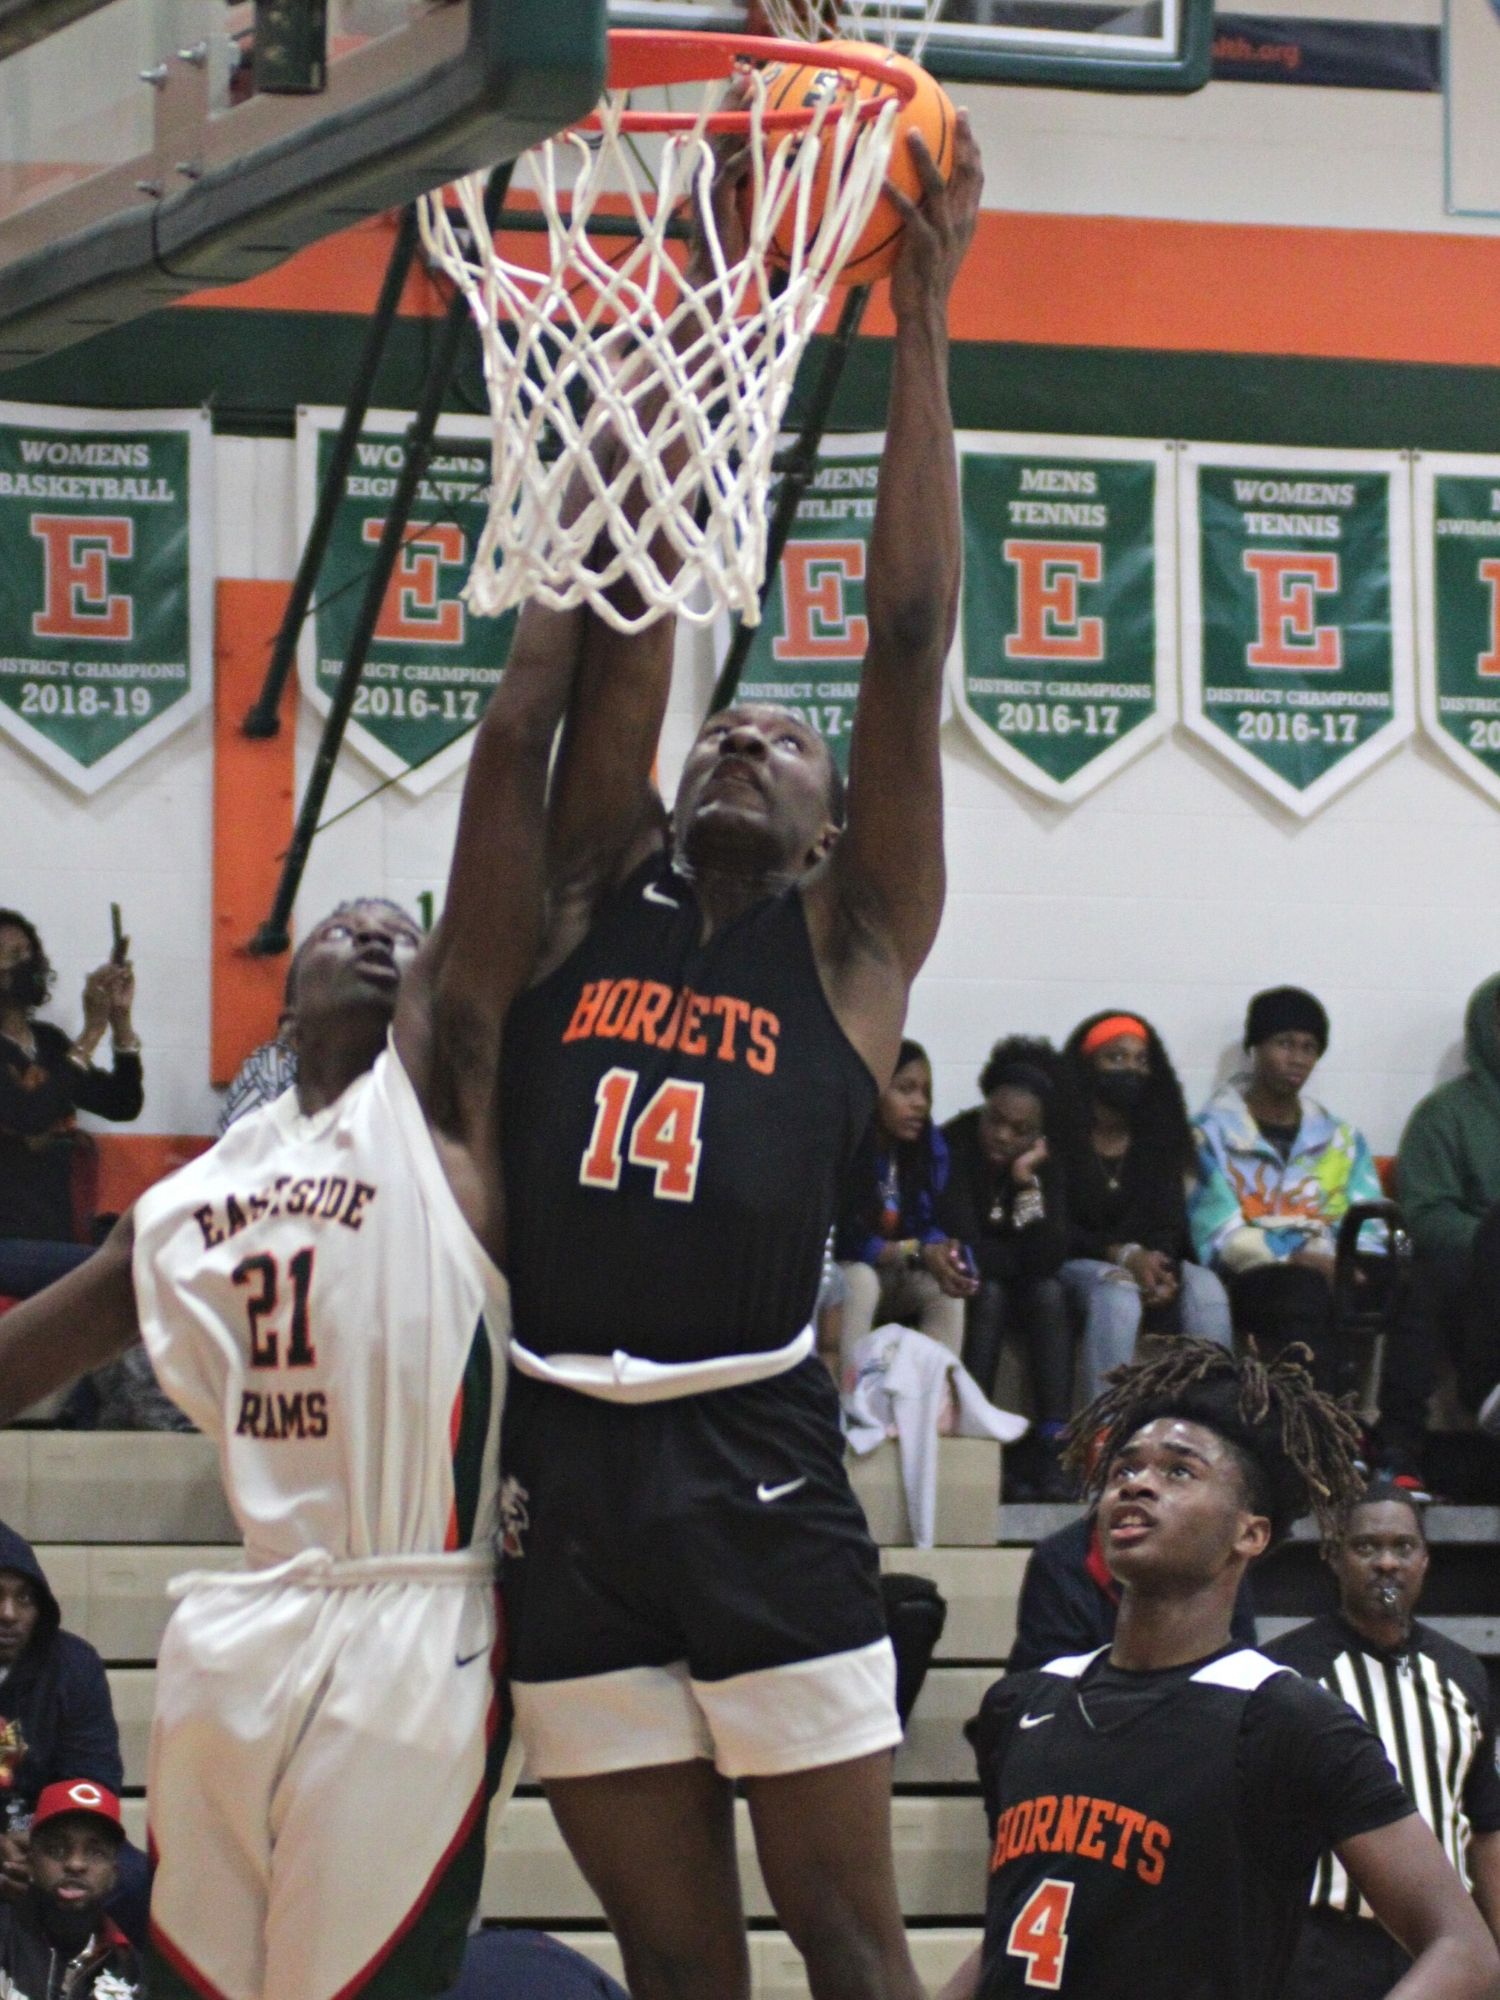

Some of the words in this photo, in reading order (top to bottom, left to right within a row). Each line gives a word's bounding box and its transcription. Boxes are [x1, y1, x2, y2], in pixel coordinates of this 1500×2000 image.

[19, 440, 150, 467] WOMENS
[355, 443, 486, 474] WOENS
[0, 473, 174, 501] BASKETBALL
[1021, 469, 1096, 493] MENS
[1233, 480, 1355, 506] WOMENS
[1009, 501, 1107, 527] TENNIS
[1243, 512, 1341, 538] TENNIS
[31, 513, 133, 640] E
[361, 517, 466, 645] E
[773, 539, 869, 660] E
[1003, 538, 1104, 661] E
[1243, 550, 1342, 671] E
[0, 658, 70, 677] ISTRICT
[72, 662, 186, 680] CHAMPIONS
[320, 659, 400, 679] DIICT
[402, 665, 507, 684] CHAMPION
[20, 682, 152, 716] 2018-19
[352, 685, 479, 721] 2016-17
[738, 682, 812, 698] DISTRICT
[968, 677, 1042, 697] DISTRICT
[1045, 681, 1151, 699] CHAMPIONS
[1206, 687, 1282, 705] DISTRICT
[1286, 690, 1389, 708] CHAMPIONS
[997, 702, 1120, 735] 2016-17
[1236, 711, 1358, 743] 2016-17
[579, 1066, 705, 1203] 14
[231, 1246, 317, 1370] 21
[988, 1795, 1172, 1885] HORNETS
[1006, 1878, 1075, 1990] 4
